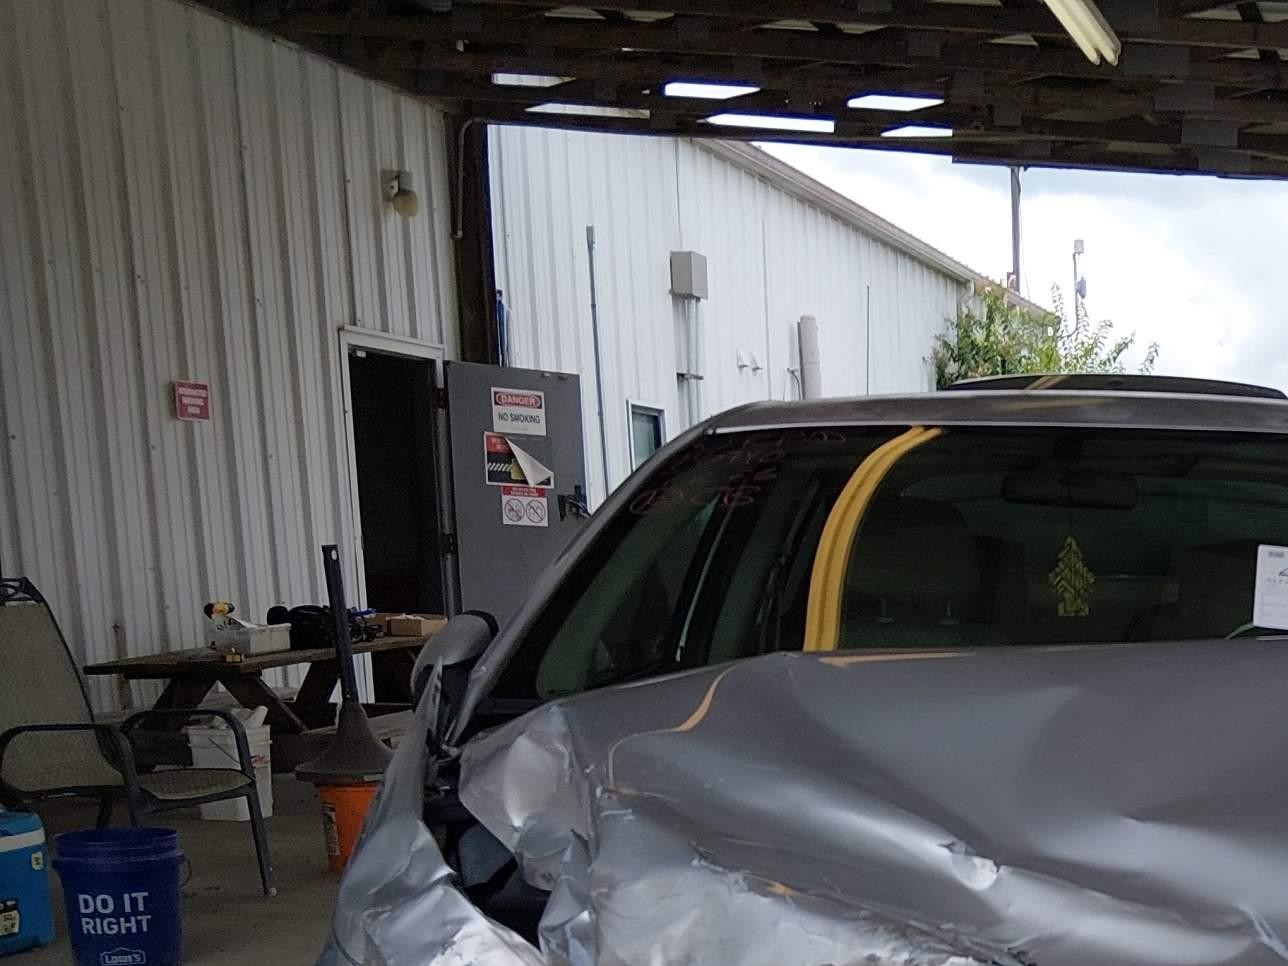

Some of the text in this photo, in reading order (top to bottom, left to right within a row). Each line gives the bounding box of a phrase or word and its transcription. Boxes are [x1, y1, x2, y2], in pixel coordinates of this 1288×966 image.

[501, 394, 536, 406] DANGER
[498, 413, 541, 424] NO SMOKING
[78, 892, 148, 914] DO IT
[81, 915, 152, 935] RIGHT
